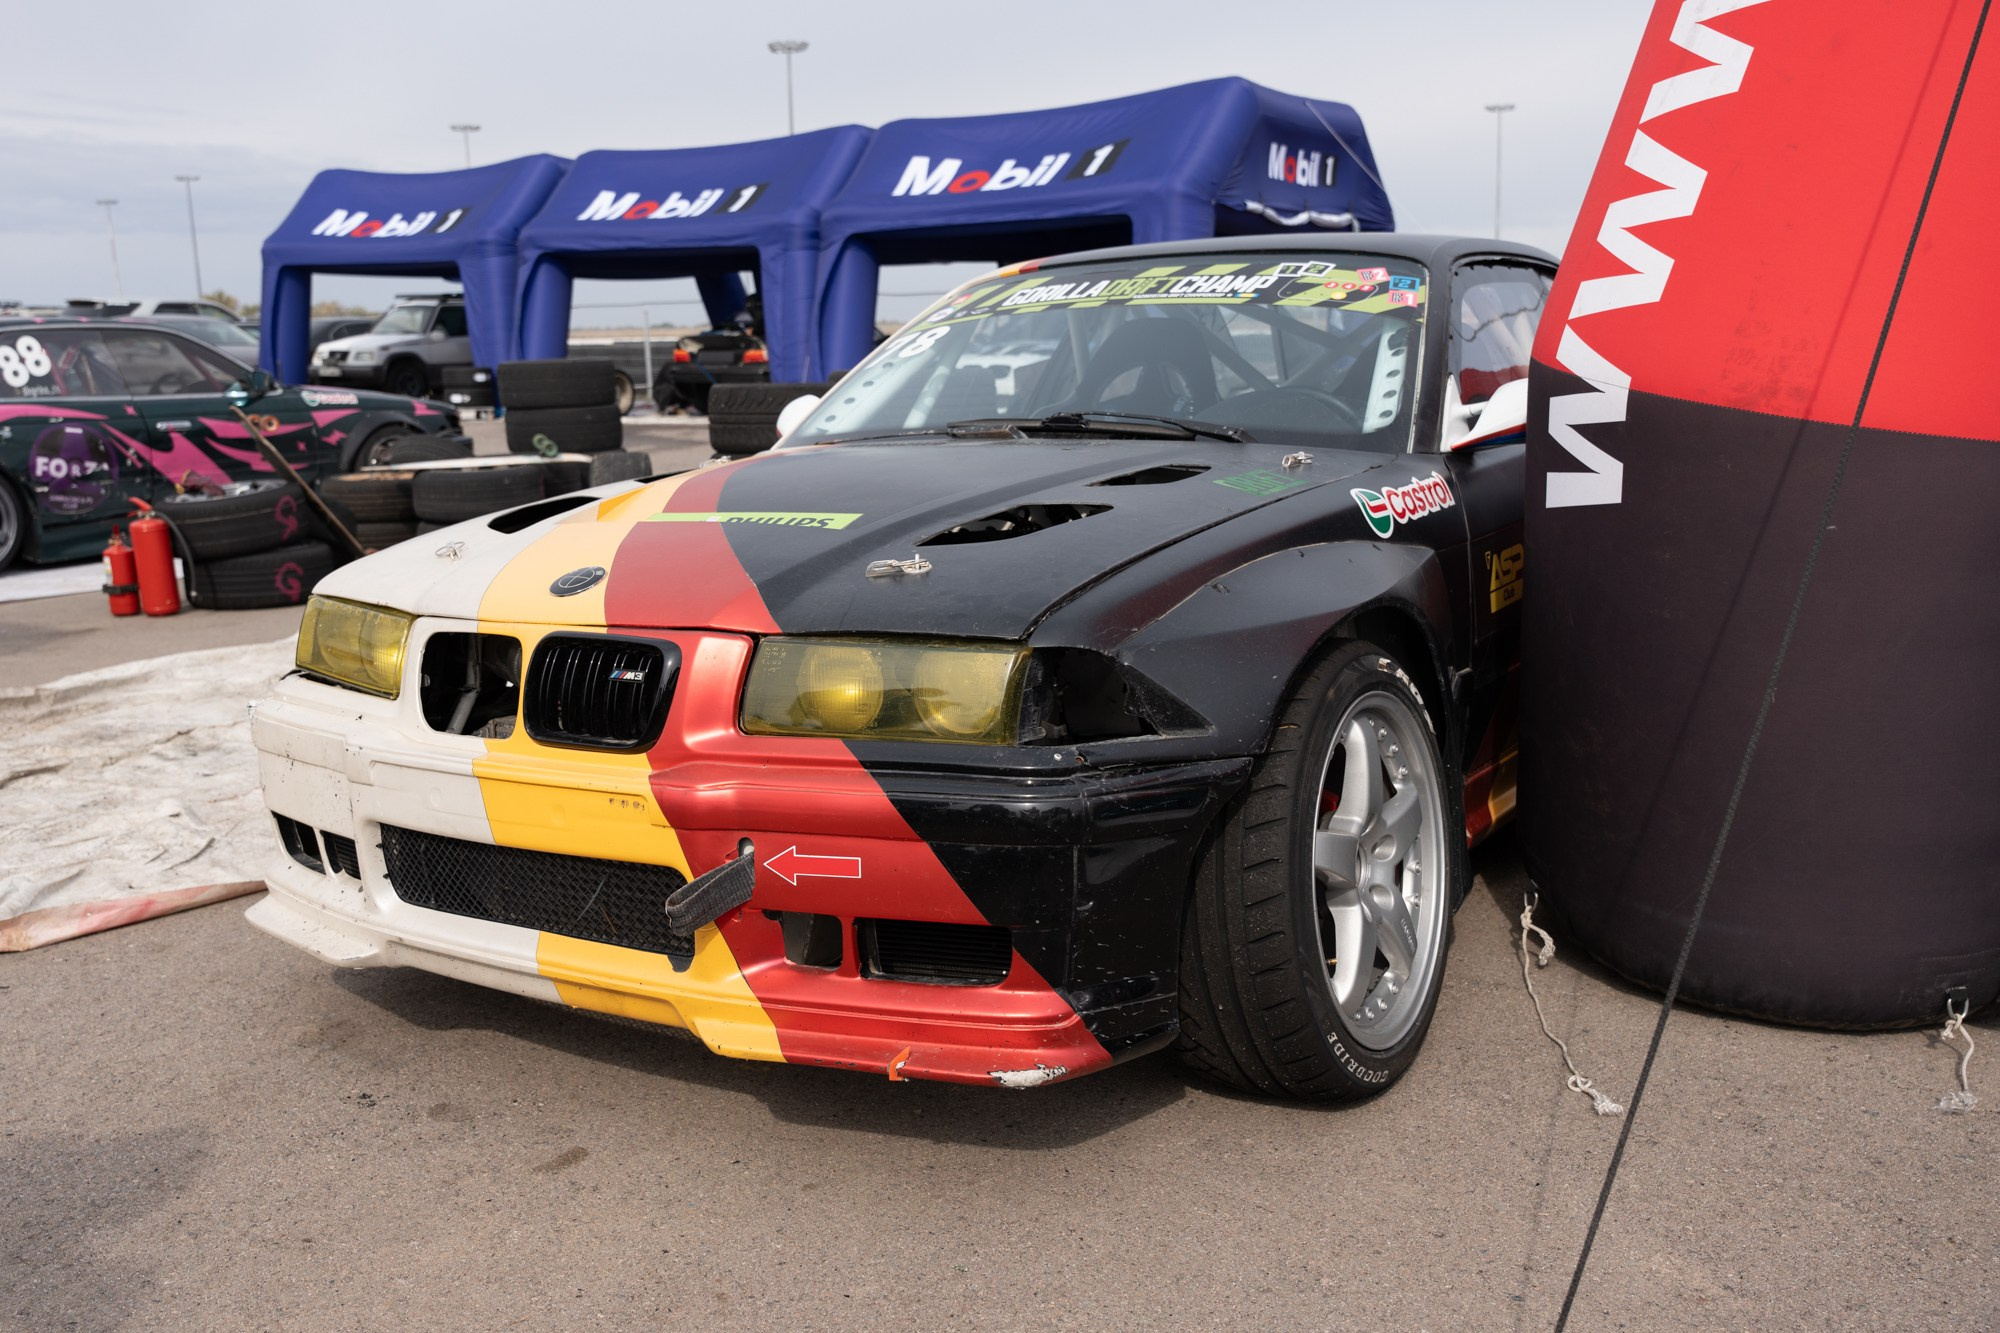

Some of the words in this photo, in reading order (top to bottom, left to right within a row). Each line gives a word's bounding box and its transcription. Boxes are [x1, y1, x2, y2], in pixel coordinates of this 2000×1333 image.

[890, 151, 1072, 197] Mobil
[1083, 143, 1116, 177] 1
[1267, 142, 1322, 188] Mobil
[1325, 154, 1337, 188] 1
[311, 208, 437, 238] Mobil
[440, 208, 464, 234] 1
[576, 188, 725, 222] Mobil
[728, 184, 759, 214] 1
[1374, 269, 1387, 281] 2
[0, 334, 52, 388] 88
[1384, 472, 1453, 521] Castrol
